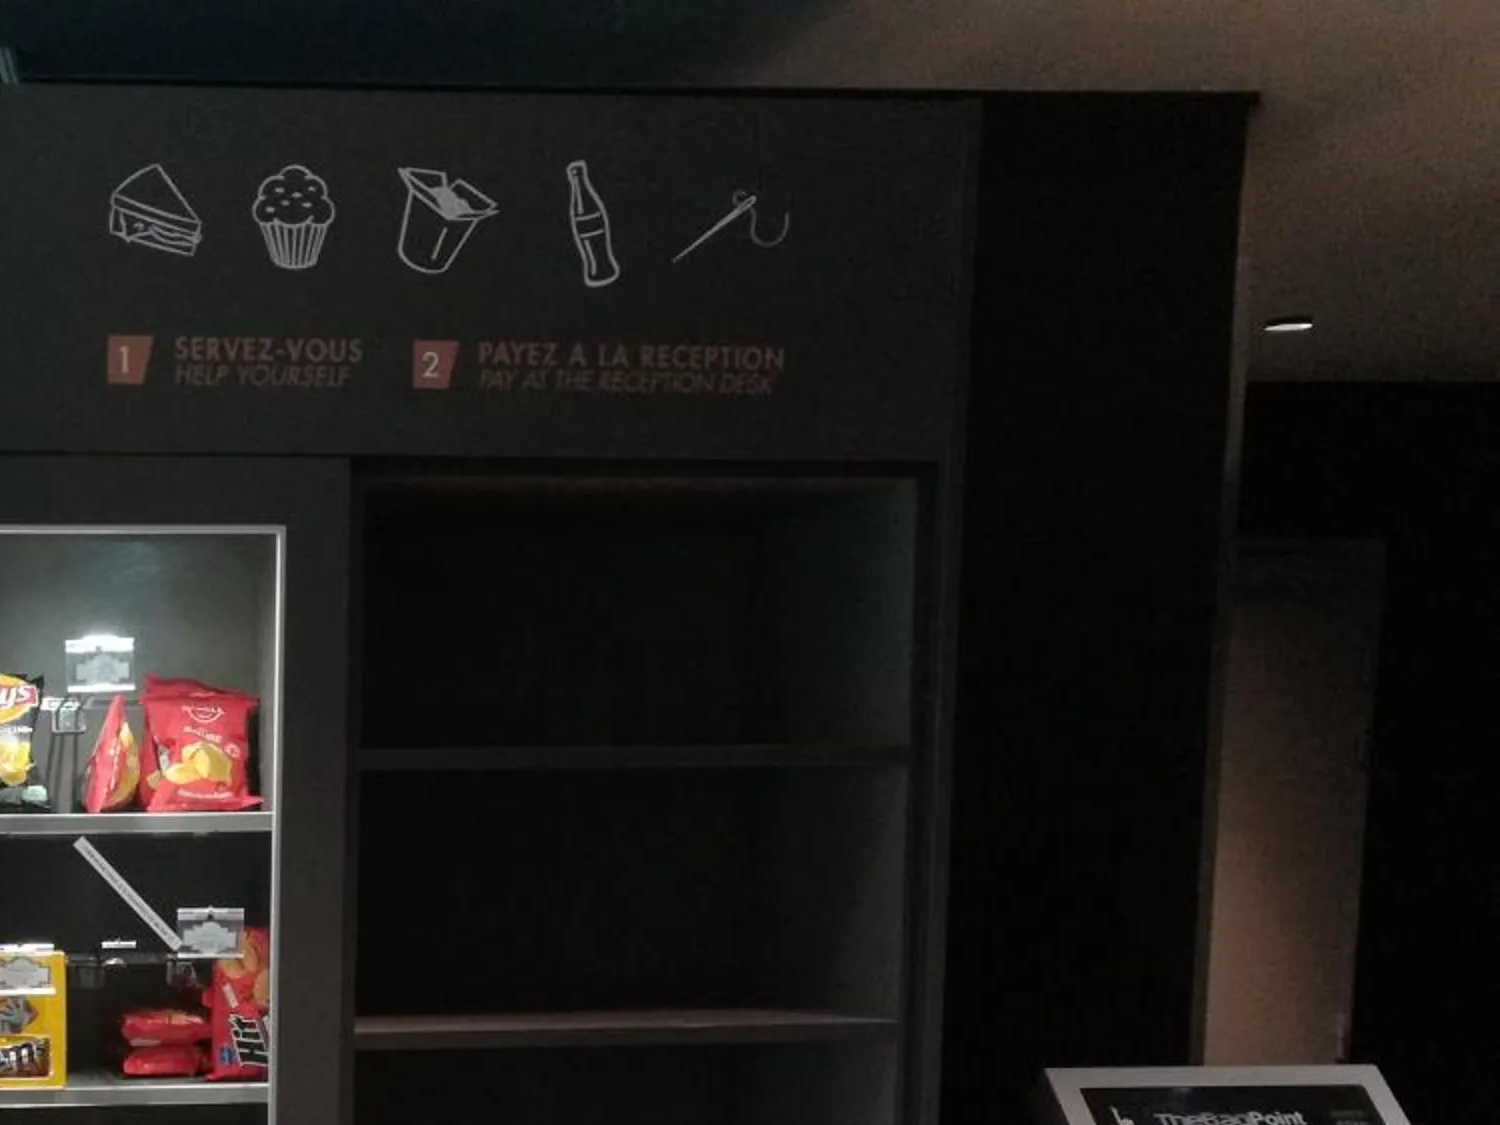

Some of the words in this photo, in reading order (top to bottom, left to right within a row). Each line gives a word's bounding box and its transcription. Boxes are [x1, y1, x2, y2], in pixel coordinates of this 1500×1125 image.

[117, 344, 132, 374] 1
[174, 336, 364, 364] SERVEZ-VOUS
[478, 341, 560, 367] PAYEZ
[567, 343, 589, 367] A
[597, 344, 630, 368] LA
[641, 345, 786, 371] RECEPTION
[175, 364, 231, 387] HELP
[236, 364, 353, 388] YOURSELF
[421, 351, 441, 379] 2
[479, 368, 519, 391] PAY
[522, 369, 550, 391] AT
[554, 370, 594, 392] THE
[597, 370, 714, 394] RECEPTION
[718, 373, 773, 395] DESK
